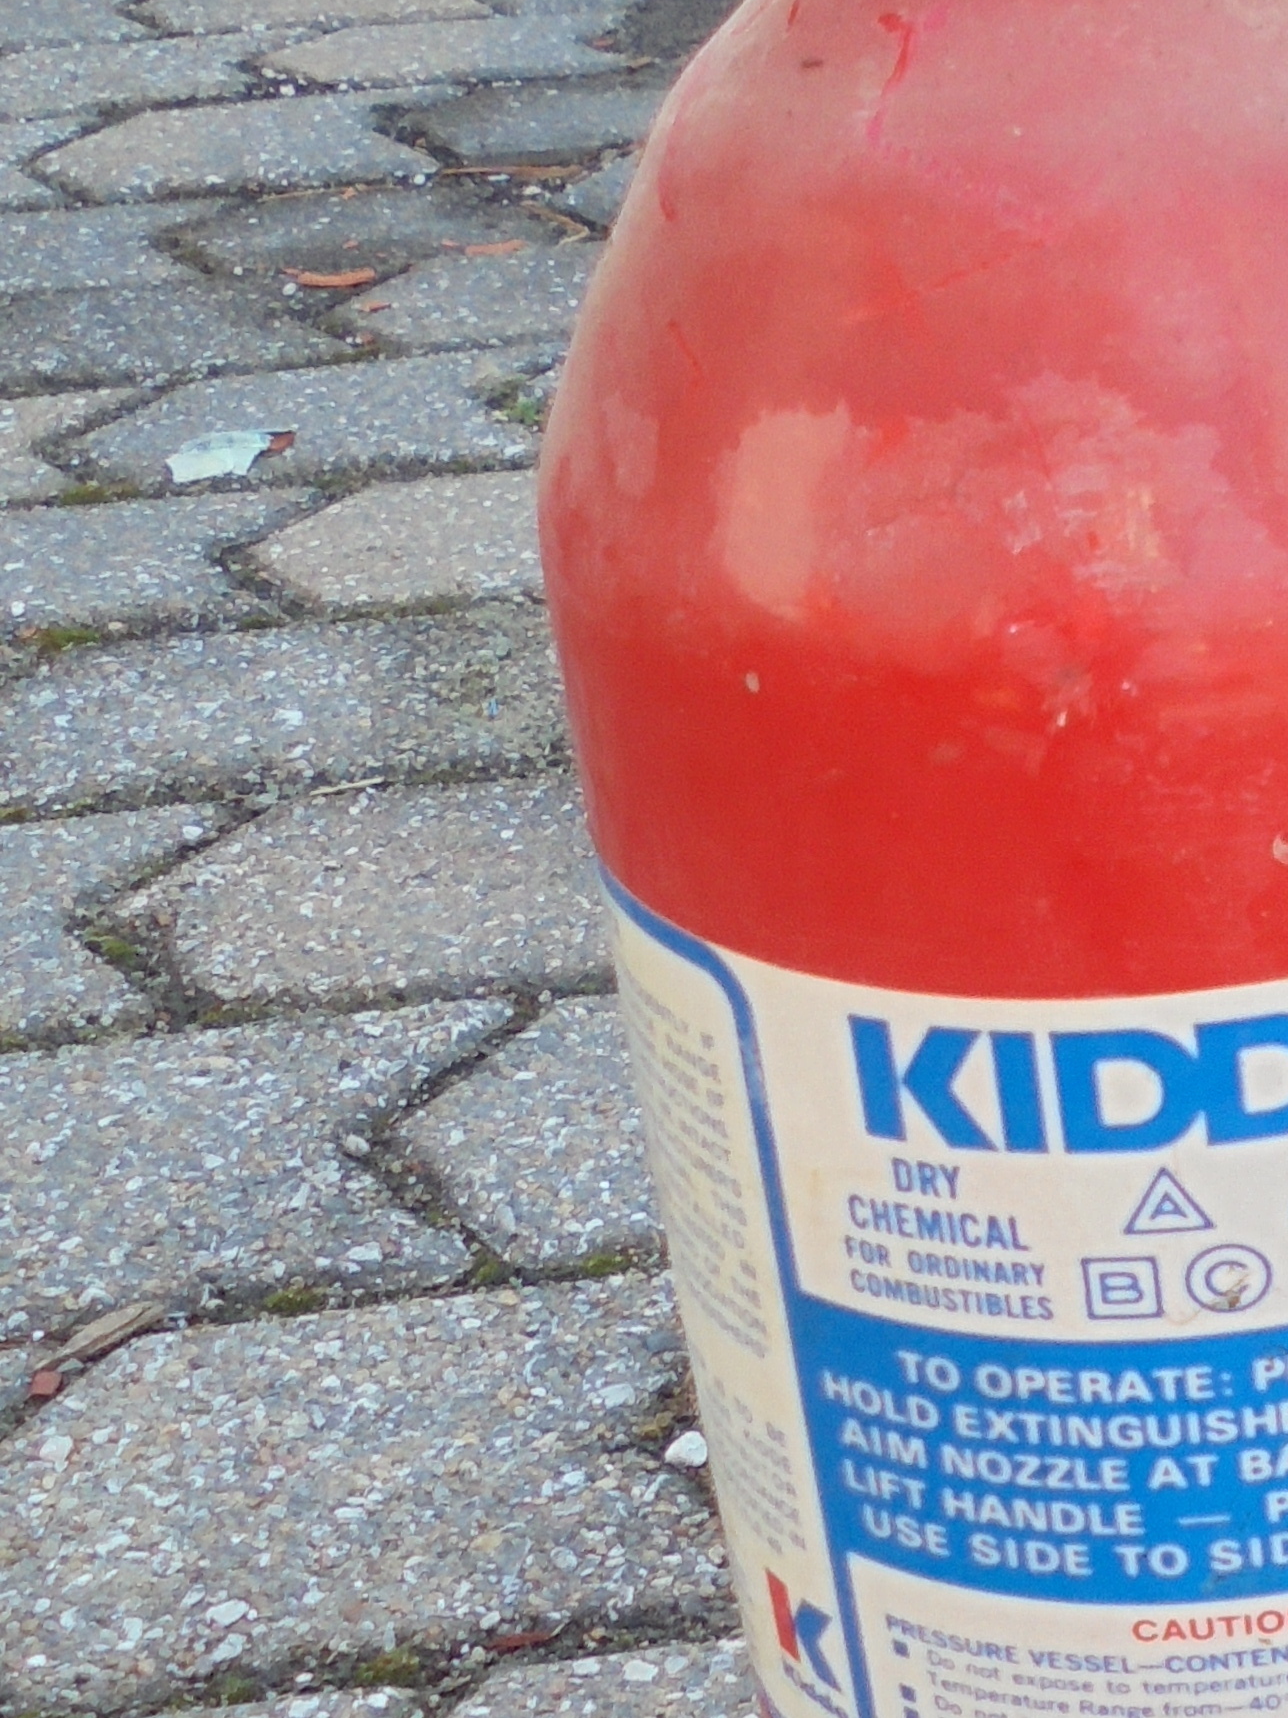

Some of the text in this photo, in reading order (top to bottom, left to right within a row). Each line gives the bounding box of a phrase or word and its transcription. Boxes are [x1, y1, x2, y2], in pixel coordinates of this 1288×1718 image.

[891, 1157, 960, 1200] DRY
[1152, 1193, 1191, 1218] A
[847, 1195, 1030, 1251] CHEMICAL
[844, 1234, 1045, 1287] FOR ORDINARY
[1204, 1261, 1249, 1298] C
[849, 1267, 1055, 1322] COMBUSTIBLES
[1099, 1273, 1142, 1304] B
[823, 1370, 938, 1429] HOLD
[896, 1349, 959, 1392] TO
[977, 1364, 1233, 1405] OPERATE:
[841, 1420, 928, 1468] AIM
[941, 1443, 1131, 1491] NOZZLE
[1148, 1455, 1220, 1490] AT
[841, 1459, 926, 1510] LIFT
[945, 1488, 1146, 1536] HANDLE
[863, 1507, 951, 1558] USE
[972, 1533, 1094, 1577] SIDE
[1115, 1544, 1189, 1577] TO
[885, 1613, 1019, 1665] PRESSURE
